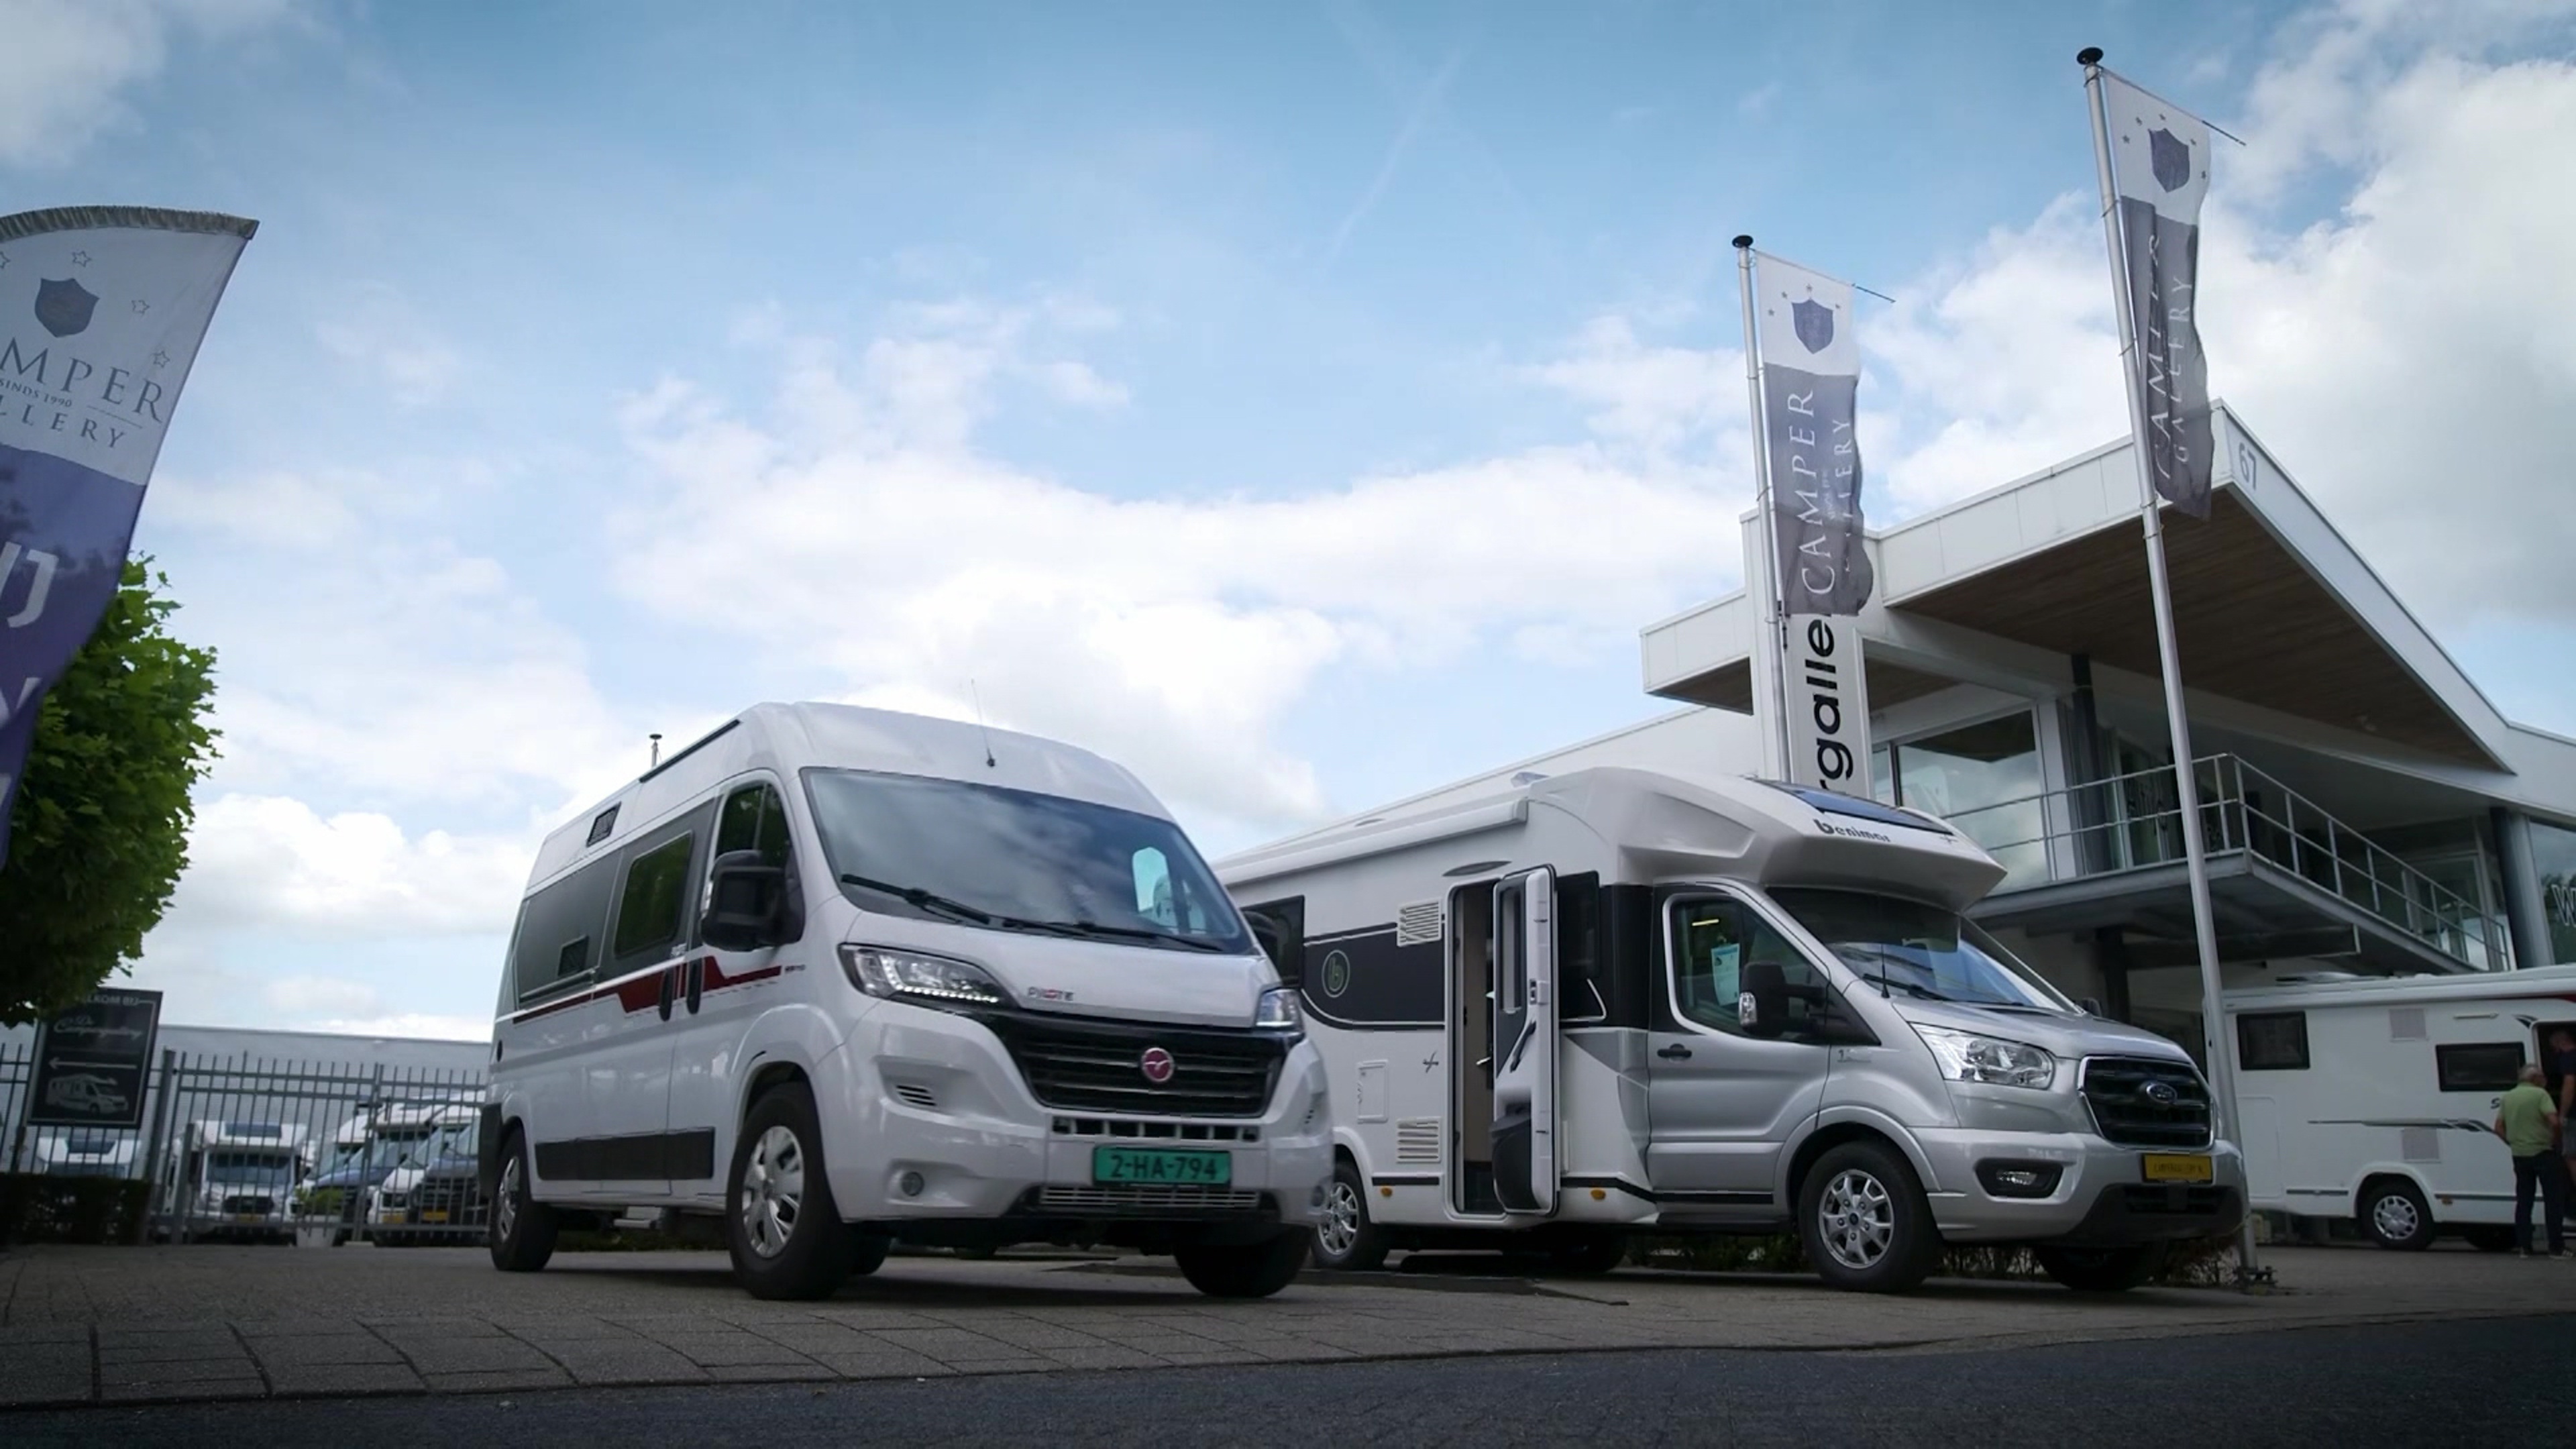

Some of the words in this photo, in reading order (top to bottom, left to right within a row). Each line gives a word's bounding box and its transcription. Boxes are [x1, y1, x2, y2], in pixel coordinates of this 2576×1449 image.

[1787, 390, 1835, 595] CAMPER
[2239, 441, 2257, 491] 67
[1805, 619, 1854, 790] galle
[1111, 1154, 1218, 1181] 2-HA-794
